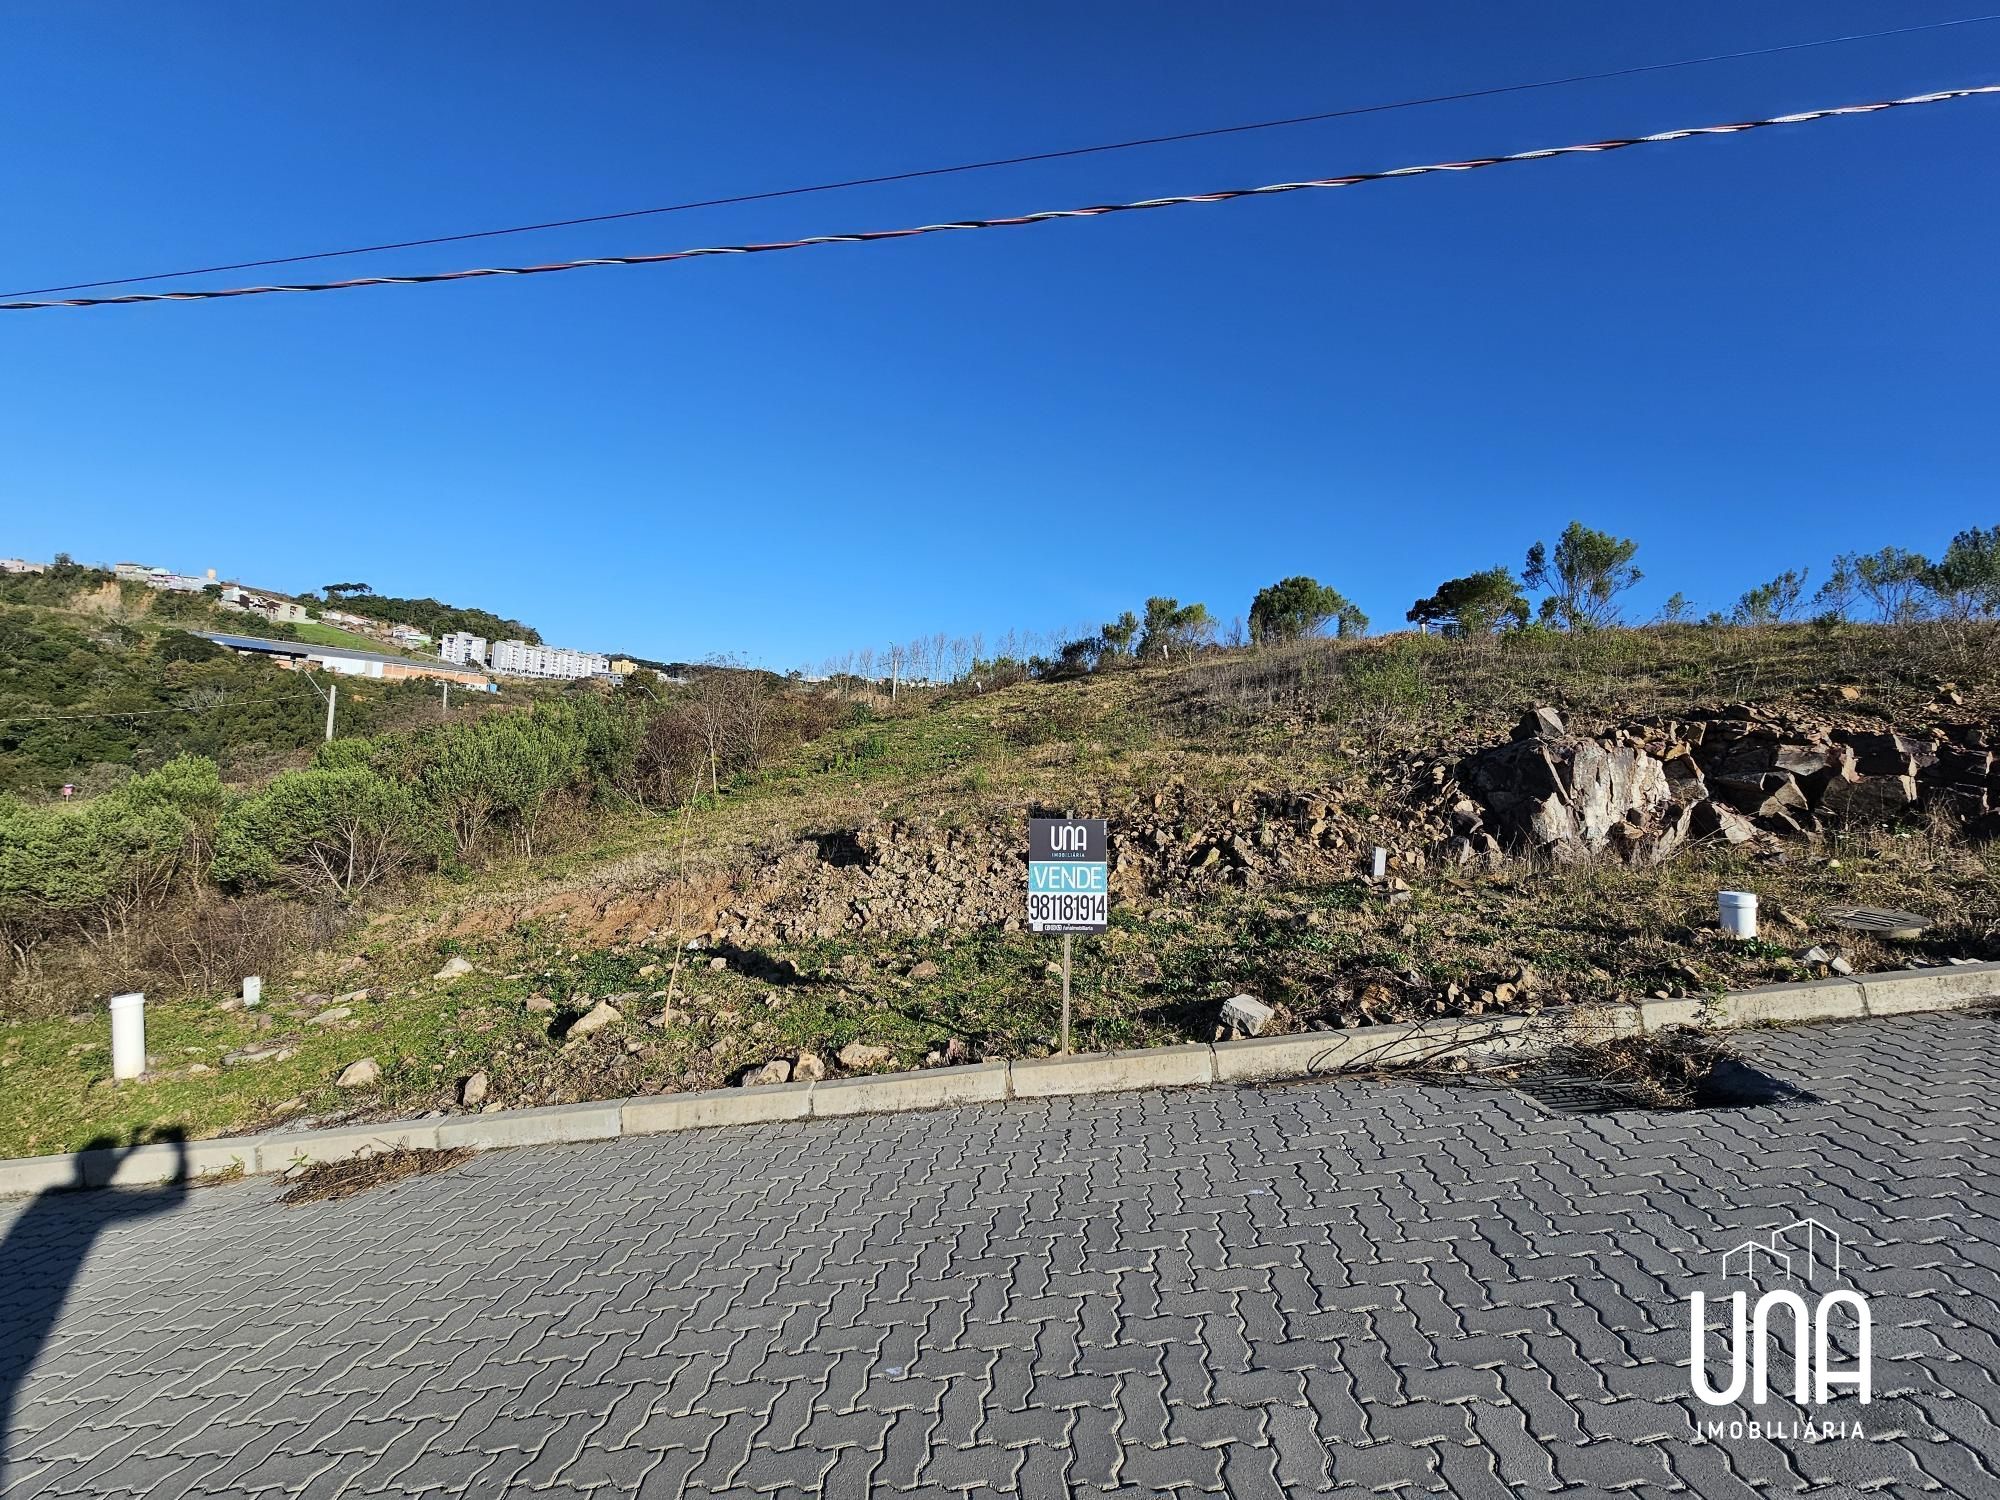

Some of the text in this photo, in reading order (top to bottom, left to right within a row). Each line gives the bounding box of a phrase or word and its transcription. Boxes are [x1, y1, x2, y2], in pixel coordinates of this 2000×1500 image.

[1050, 825, 1087, 851] UNA
[1034, 866, 1103, 889] VENDE
[1030, 894, 1106, 921] 981181914
